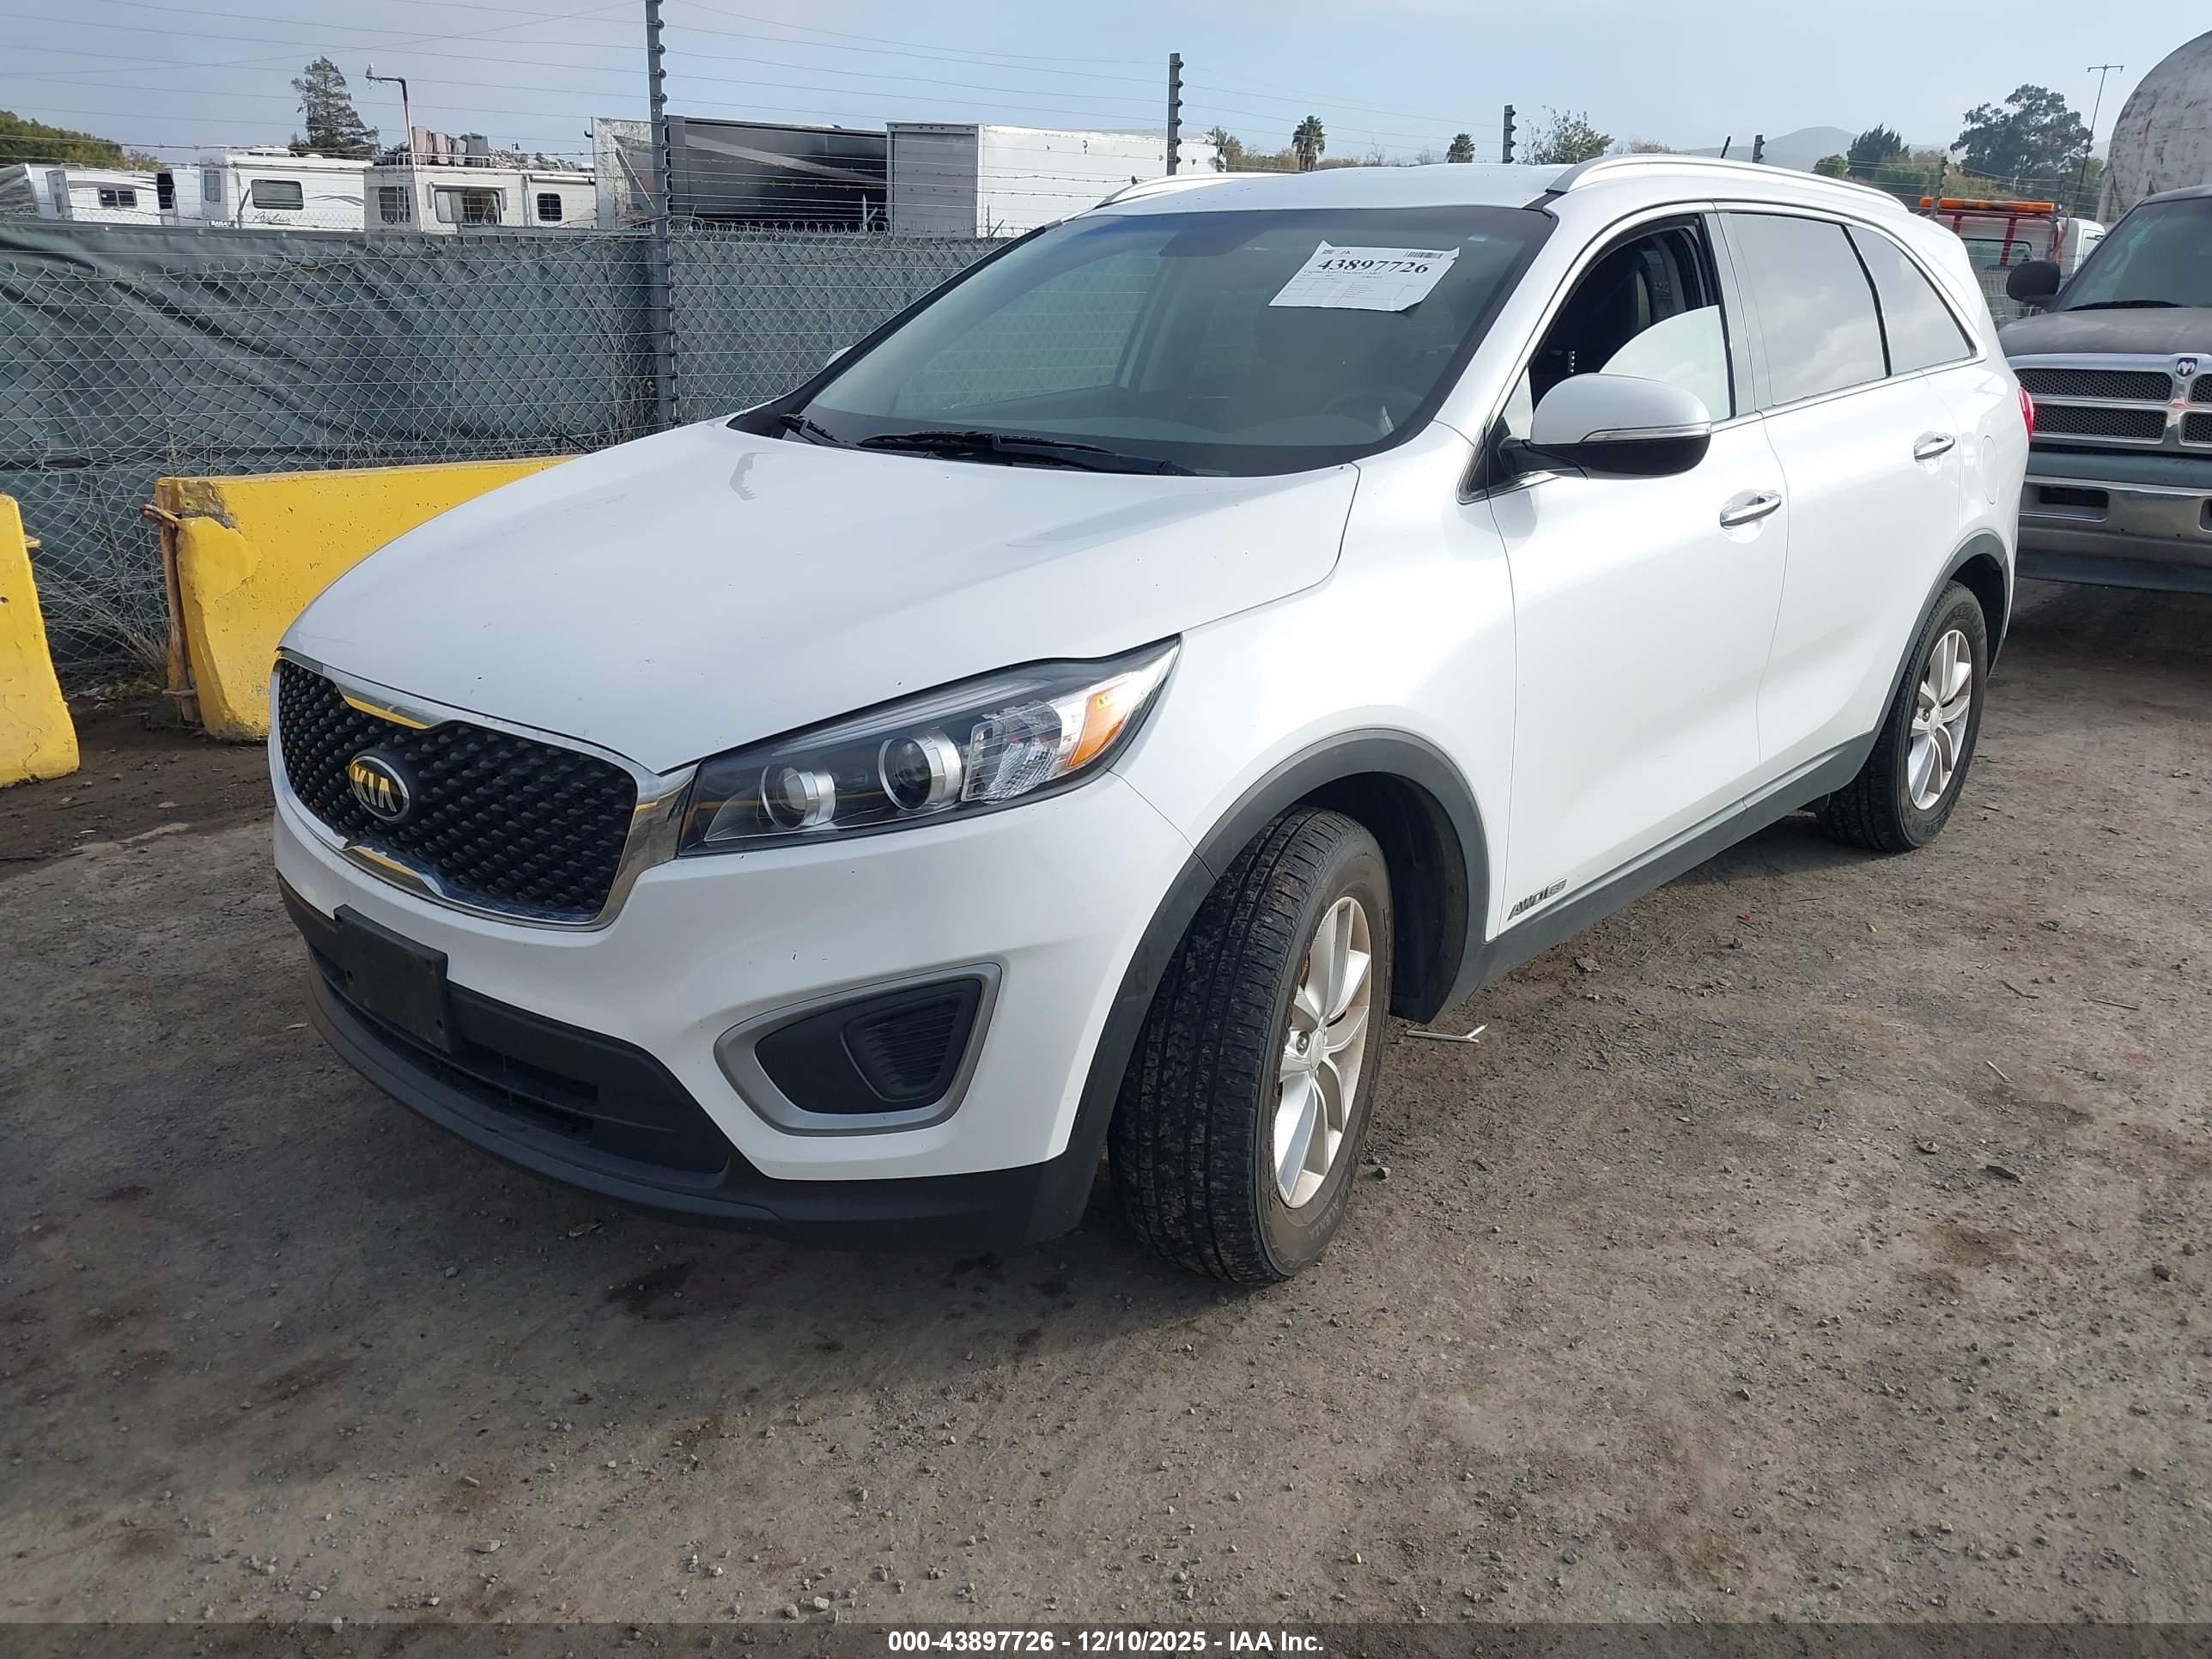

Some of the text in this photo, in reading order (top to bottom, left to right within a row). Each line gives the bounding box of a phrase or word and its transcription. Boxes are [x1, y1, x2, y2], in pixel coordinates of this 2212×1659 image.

[1317, 258, 1431, 274] 43897726
[353, 766, 398, 812] KIA
[1507, 889, 1548, 921] AWD
